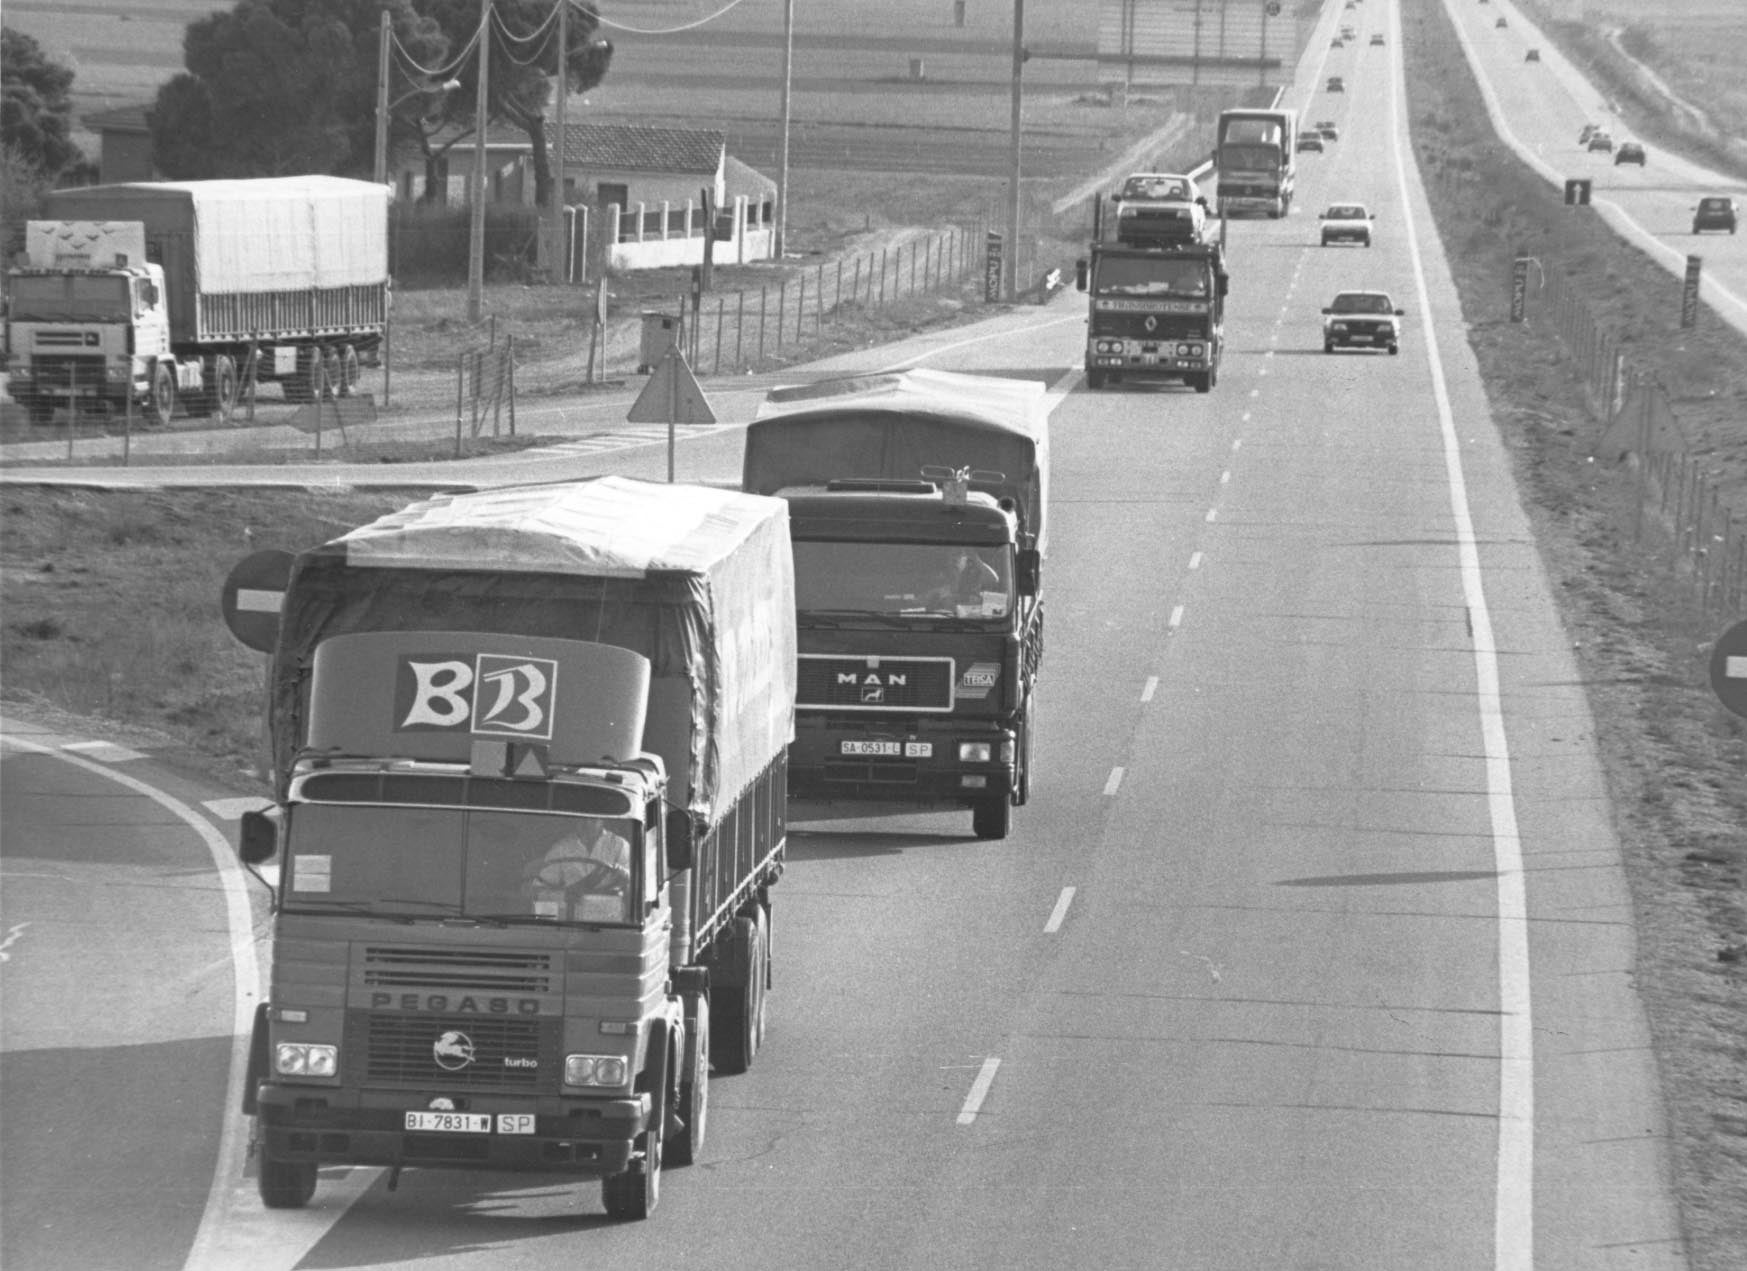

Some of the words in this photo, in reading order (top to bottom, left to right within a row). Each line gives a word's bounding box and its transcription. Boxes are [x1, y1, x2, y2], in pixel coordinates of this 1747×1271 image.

[838, 673, 906, 685] MAN
[909, 744, 930, 756] SP
[372, 992, 540, 1015] PEGASO
[504, 1057, 538, 1068] turbo
[406, 1113, 489, 1131] BI-7831-W
[502, 1116, 531, 1133] SP
